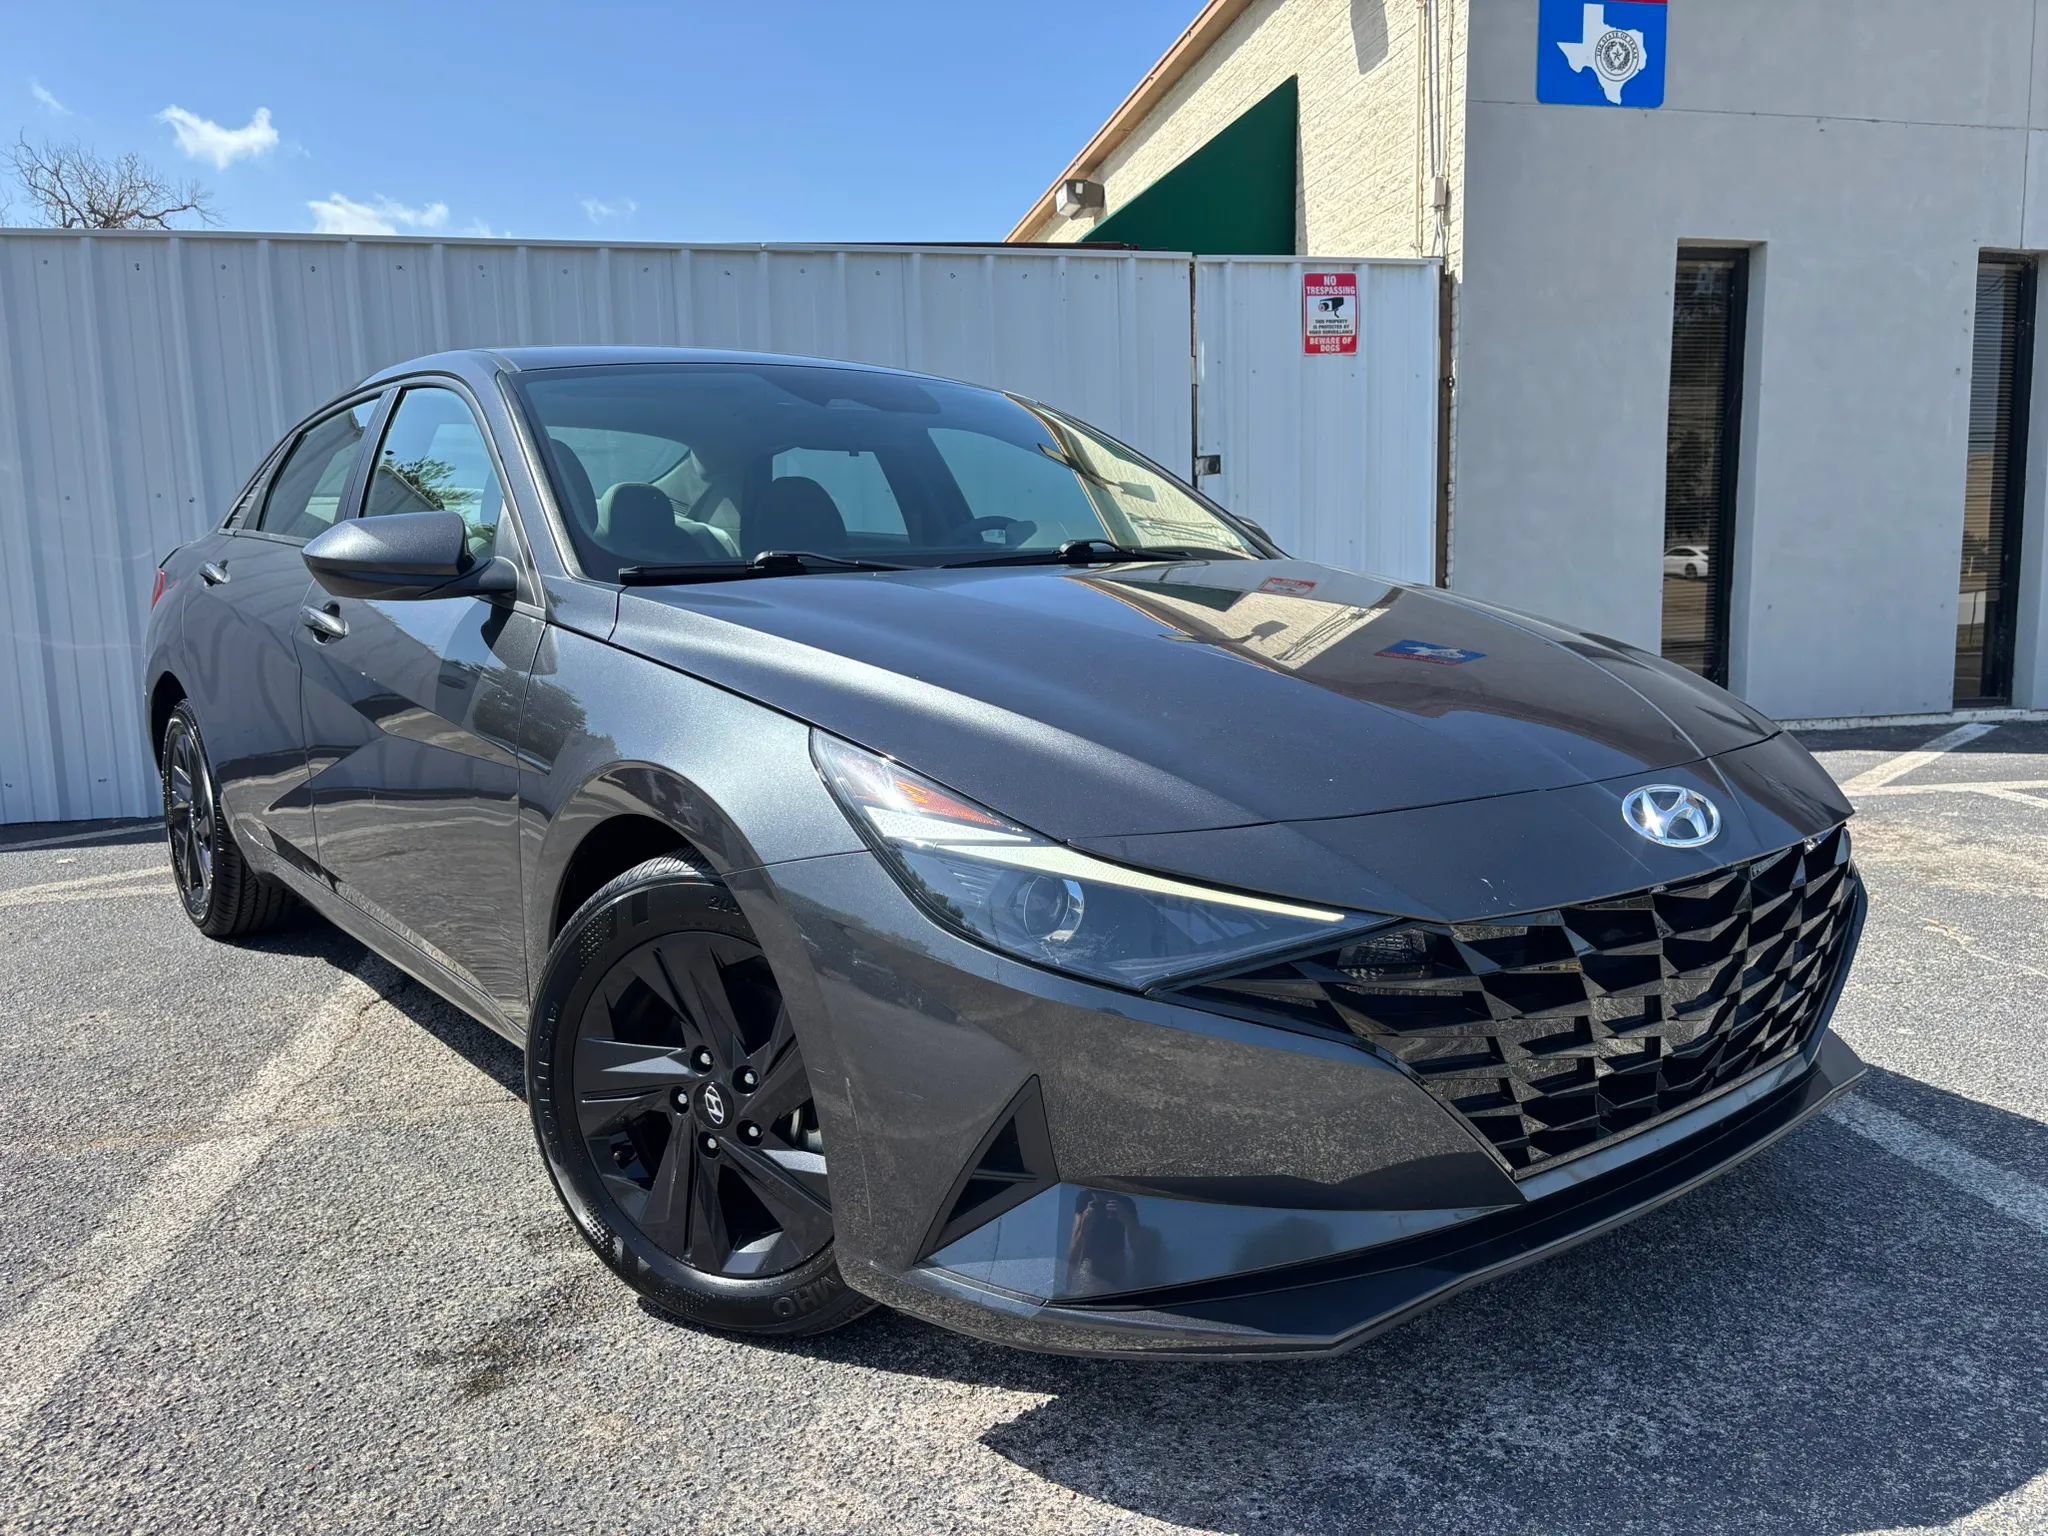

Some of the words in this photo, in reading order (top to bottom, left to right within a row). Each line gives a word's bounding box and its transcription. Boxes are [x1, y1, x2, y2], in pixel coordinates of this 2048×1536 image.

[1324, 276, 1337, 286] NO
[1307, 286, 1356, 295] TRESPASSING
[1310, 337, 1340, 345] BEWARE
[1342, 336, 1353, 344] OF
[1320, 344, 1341, 352] DOGS
